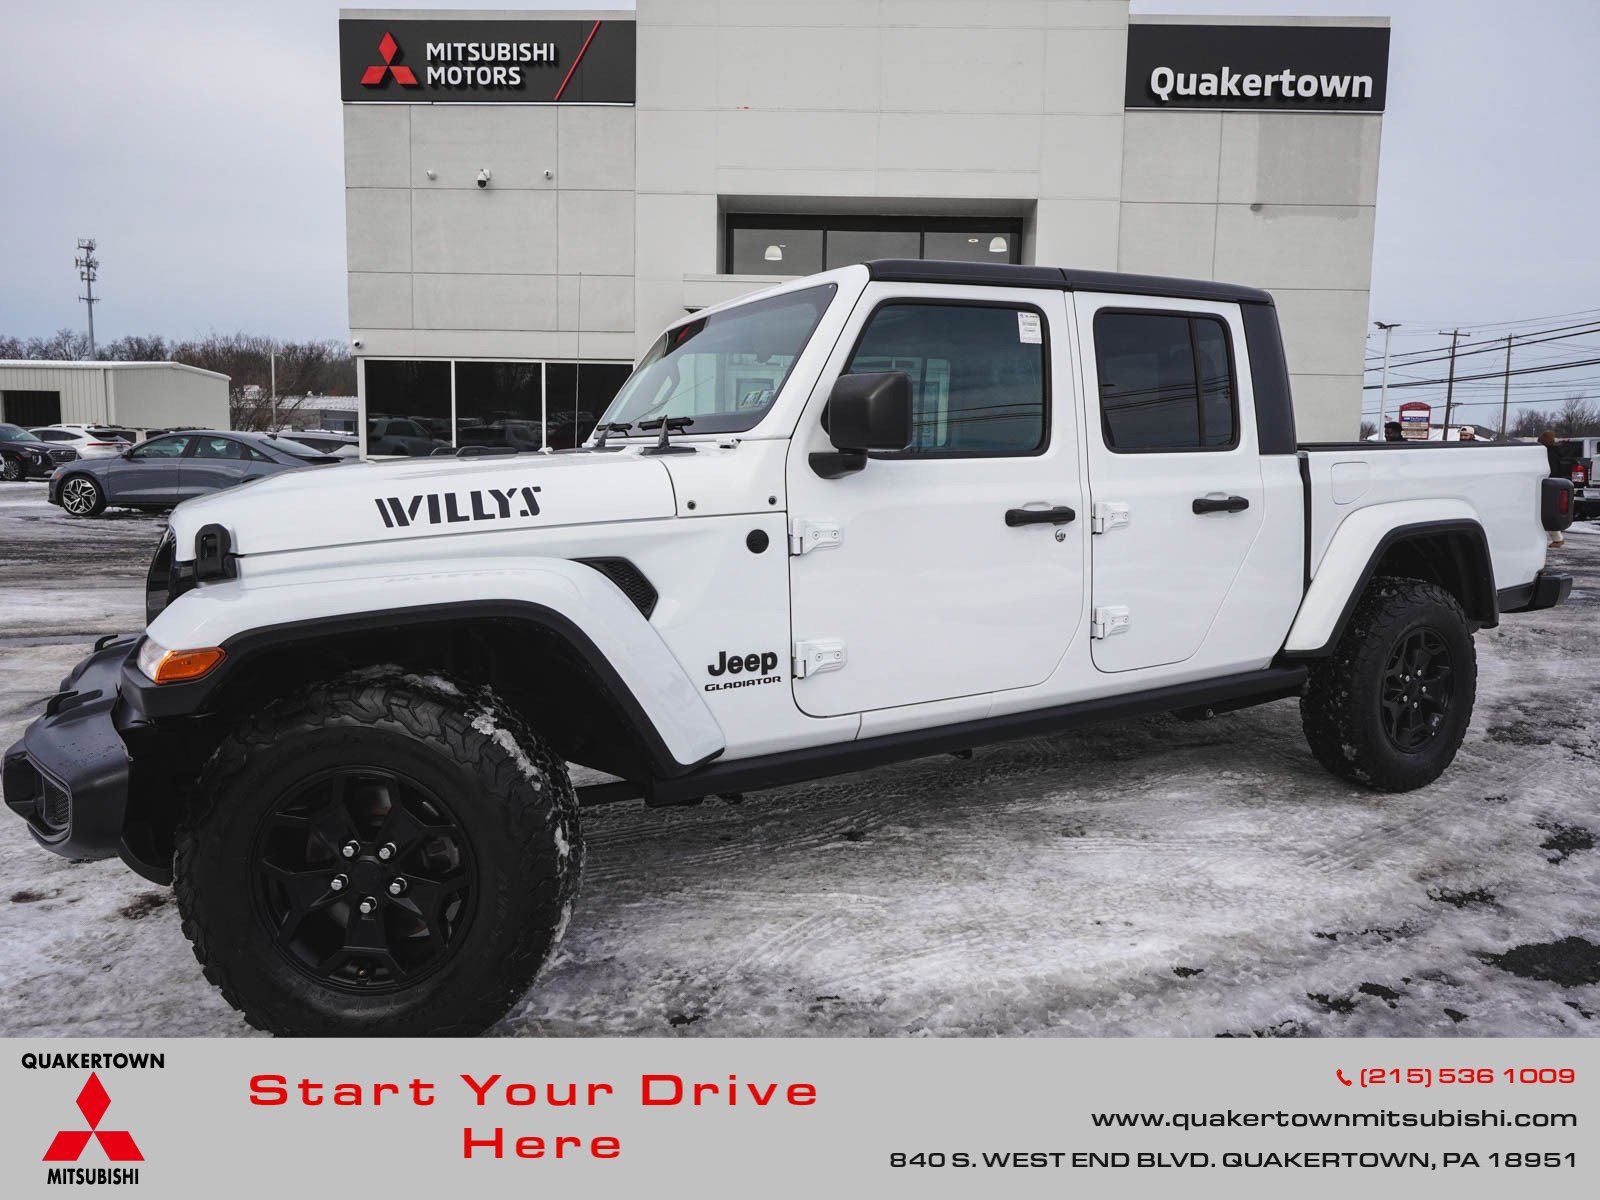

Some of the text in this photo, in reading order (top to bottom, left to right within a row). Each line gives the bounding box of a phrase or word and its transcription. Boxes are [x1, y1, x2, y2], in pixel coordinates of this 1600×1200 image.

[426, 42, 556, 62] MITSUBISHI
[426, 66, 522, 86] MOTORS
[1150, 66, 1374, 102] Quakertown
[375, 486, 542, 528] WILLYS
[707, 651, 778, 677] Jeep
[704, 675, 782, 692] GLADIATOR
